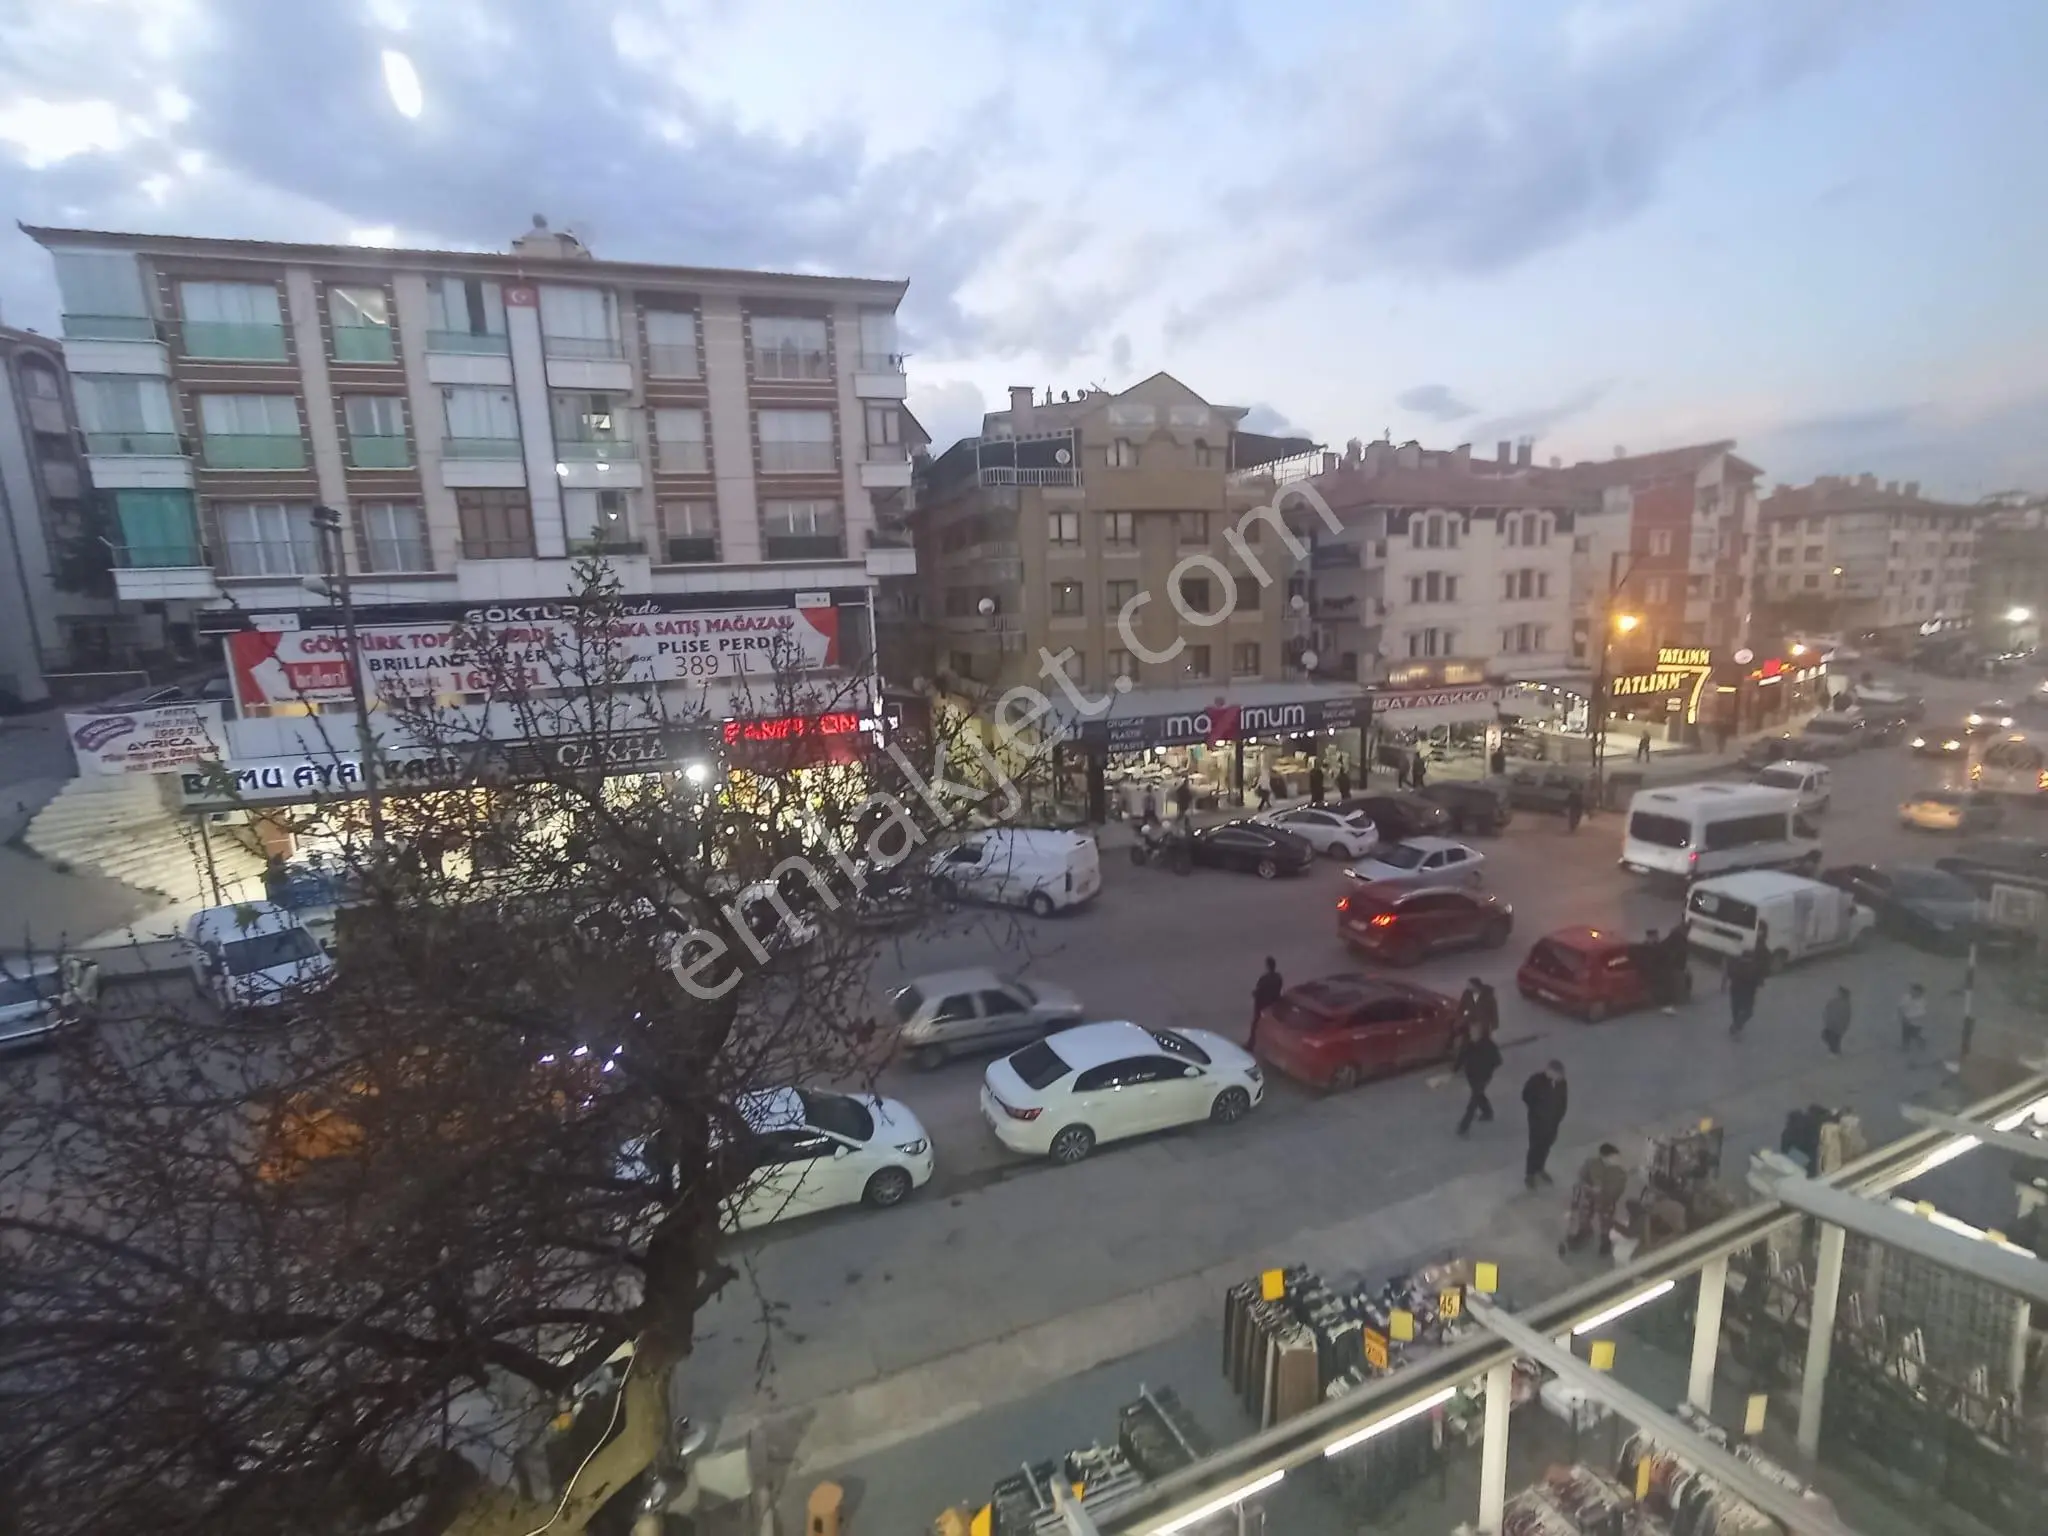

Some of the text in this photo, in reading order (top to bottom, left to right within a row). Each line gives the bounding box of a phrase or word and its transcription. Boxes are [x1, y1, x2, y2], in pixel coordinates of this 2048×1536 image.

[301, 632, 405, 654] GÖKÜRK
[675, 652, 755, 678] 389 TL
[1658, 648, 1710, 664] TATLIMM
[1613, 672, 1681, 696] TATLIMM
[127, 738, 198, 751] AYRICA
